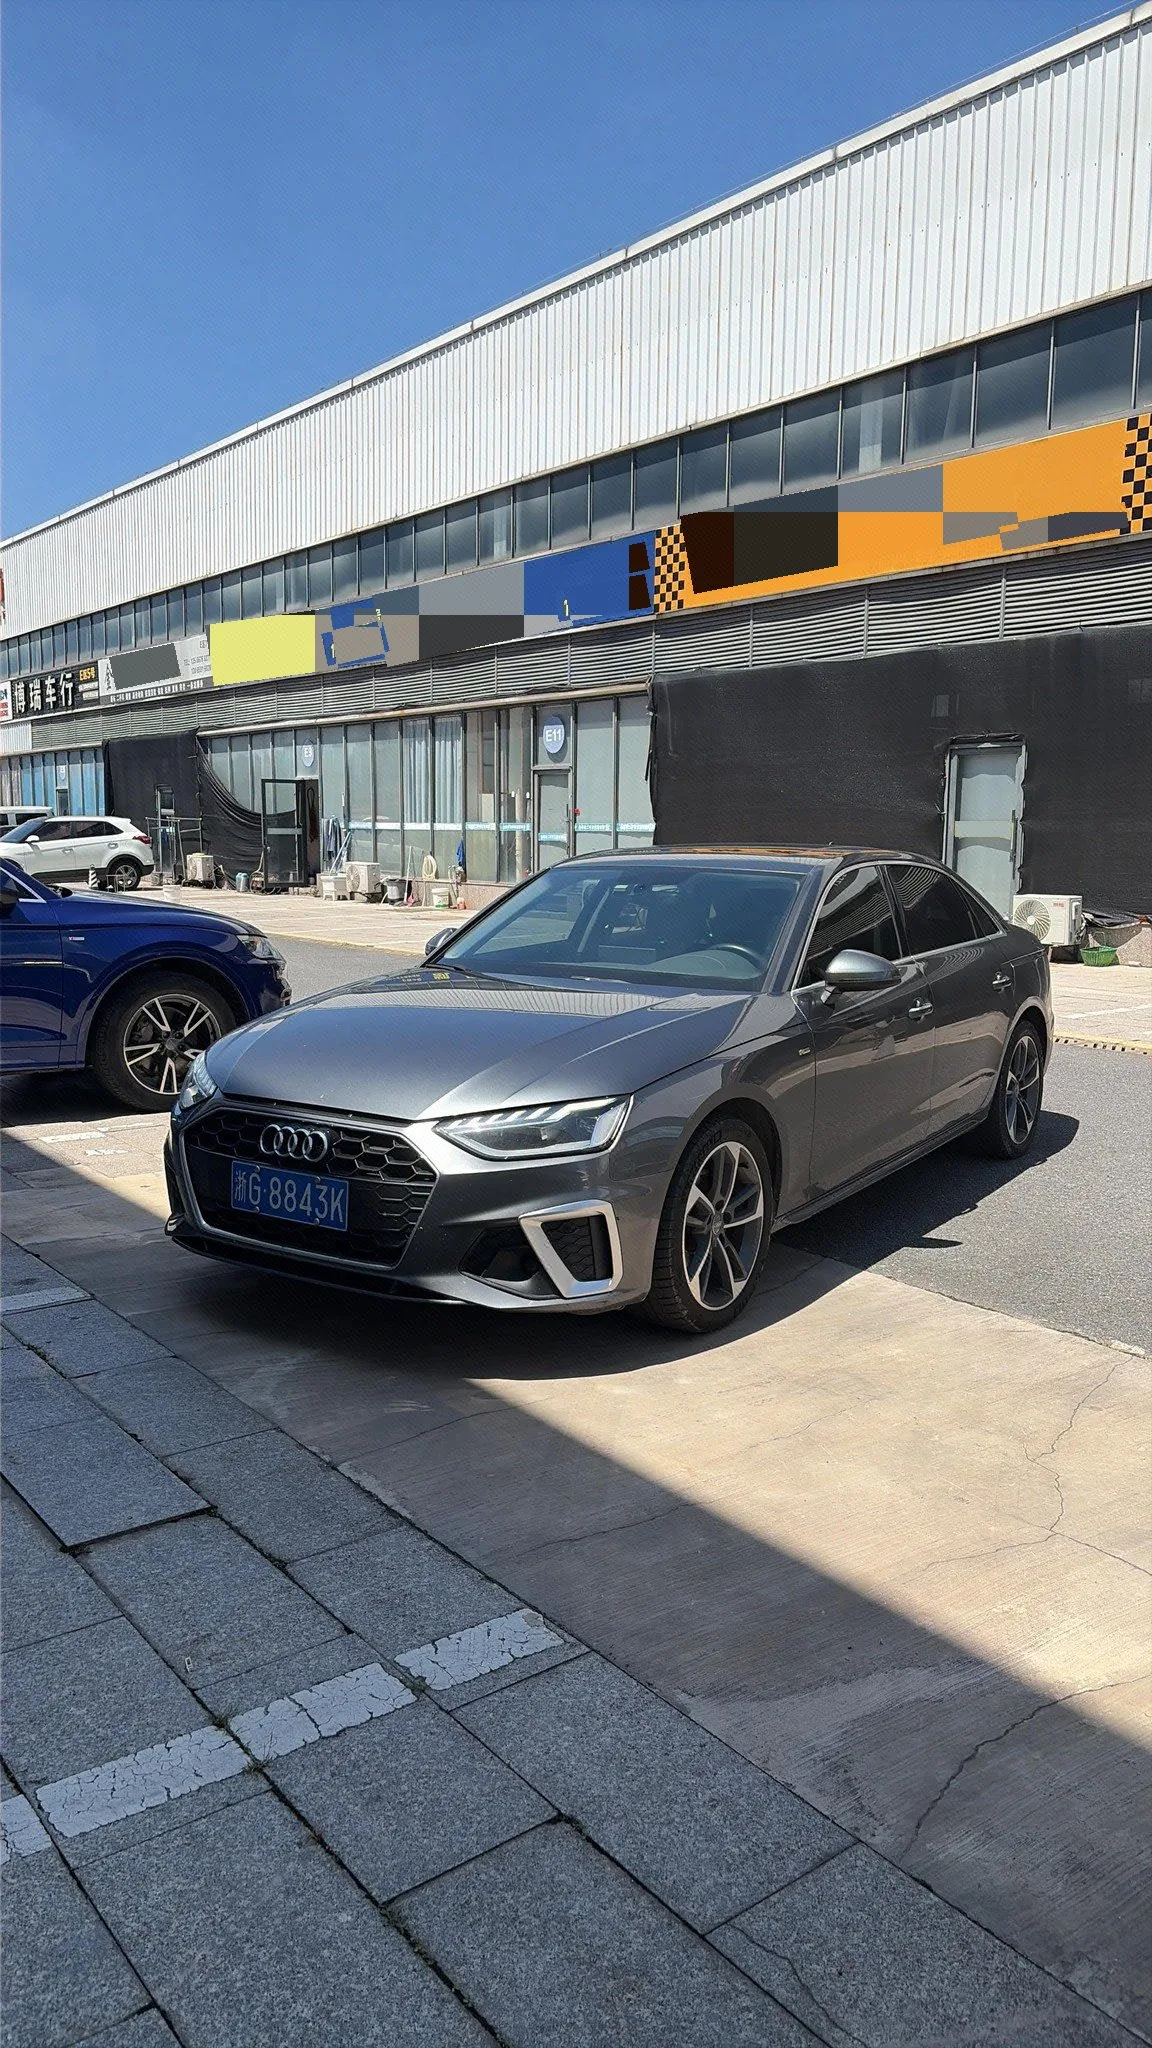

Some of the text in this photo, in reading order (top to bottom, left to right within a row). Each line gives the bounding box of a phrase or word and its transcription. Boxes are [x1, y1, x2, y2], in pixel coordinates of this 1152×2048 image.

[14, 671, 73, 714] 博瑞车行
[545, 728, 561, 742] E11
